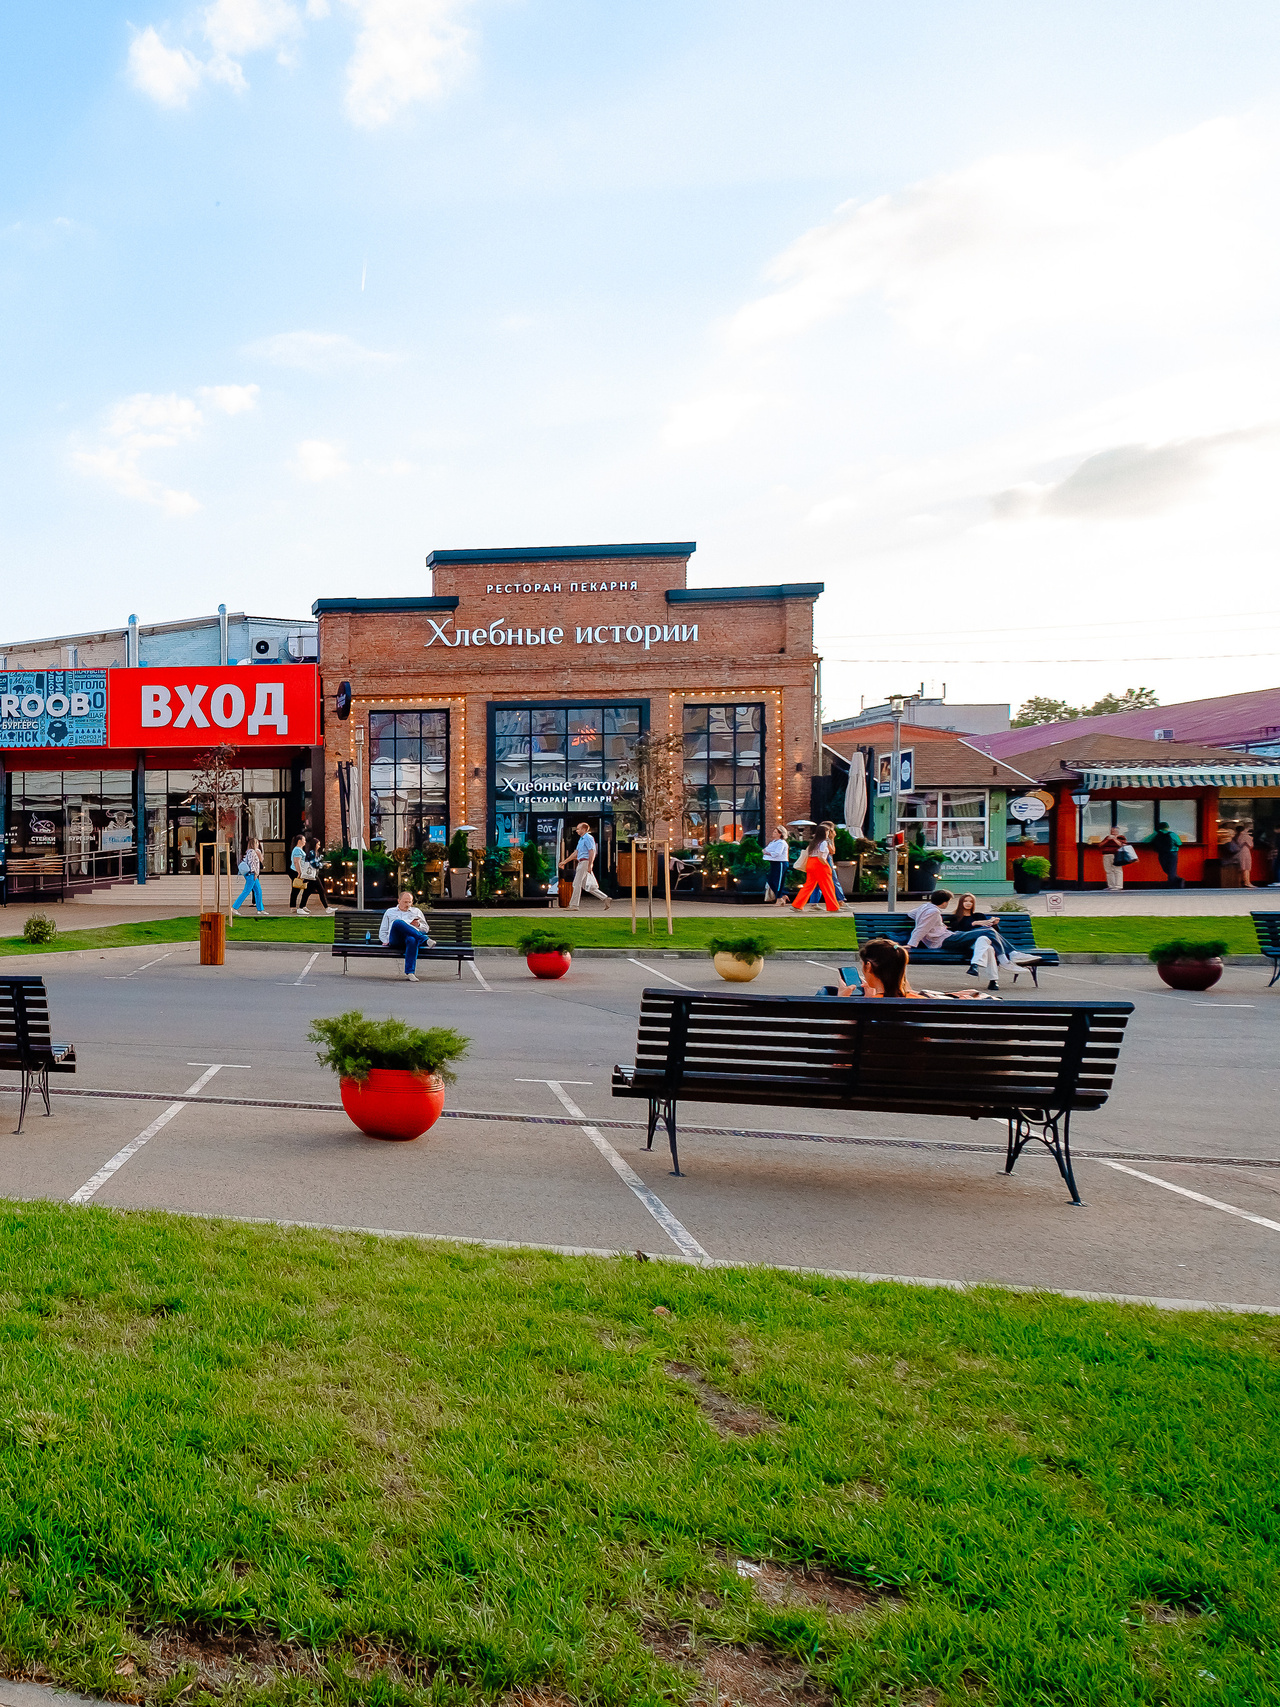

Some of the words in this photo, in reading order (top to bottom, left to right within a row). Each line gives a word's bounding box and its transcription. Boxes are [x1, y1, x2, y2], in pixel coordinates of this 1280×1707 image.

[487, 583, 562, 594] РЕСТОРАН
[570, 581, 638, 592] ПЕКАРНЯ
[424, 617, 564, 648] Хлебные
[576, 623, 699, 650] истории
[1, 693, 90, 718] ROOB
[141, 683, 289, 735] ВХОД
[2, 721, 39, 730] БУРГЕРС
[501, 776, 572, 793] Хлебные
[578, 780, 639, 795] истории
[519, 796, 568, 804] РЕСТОРАН
